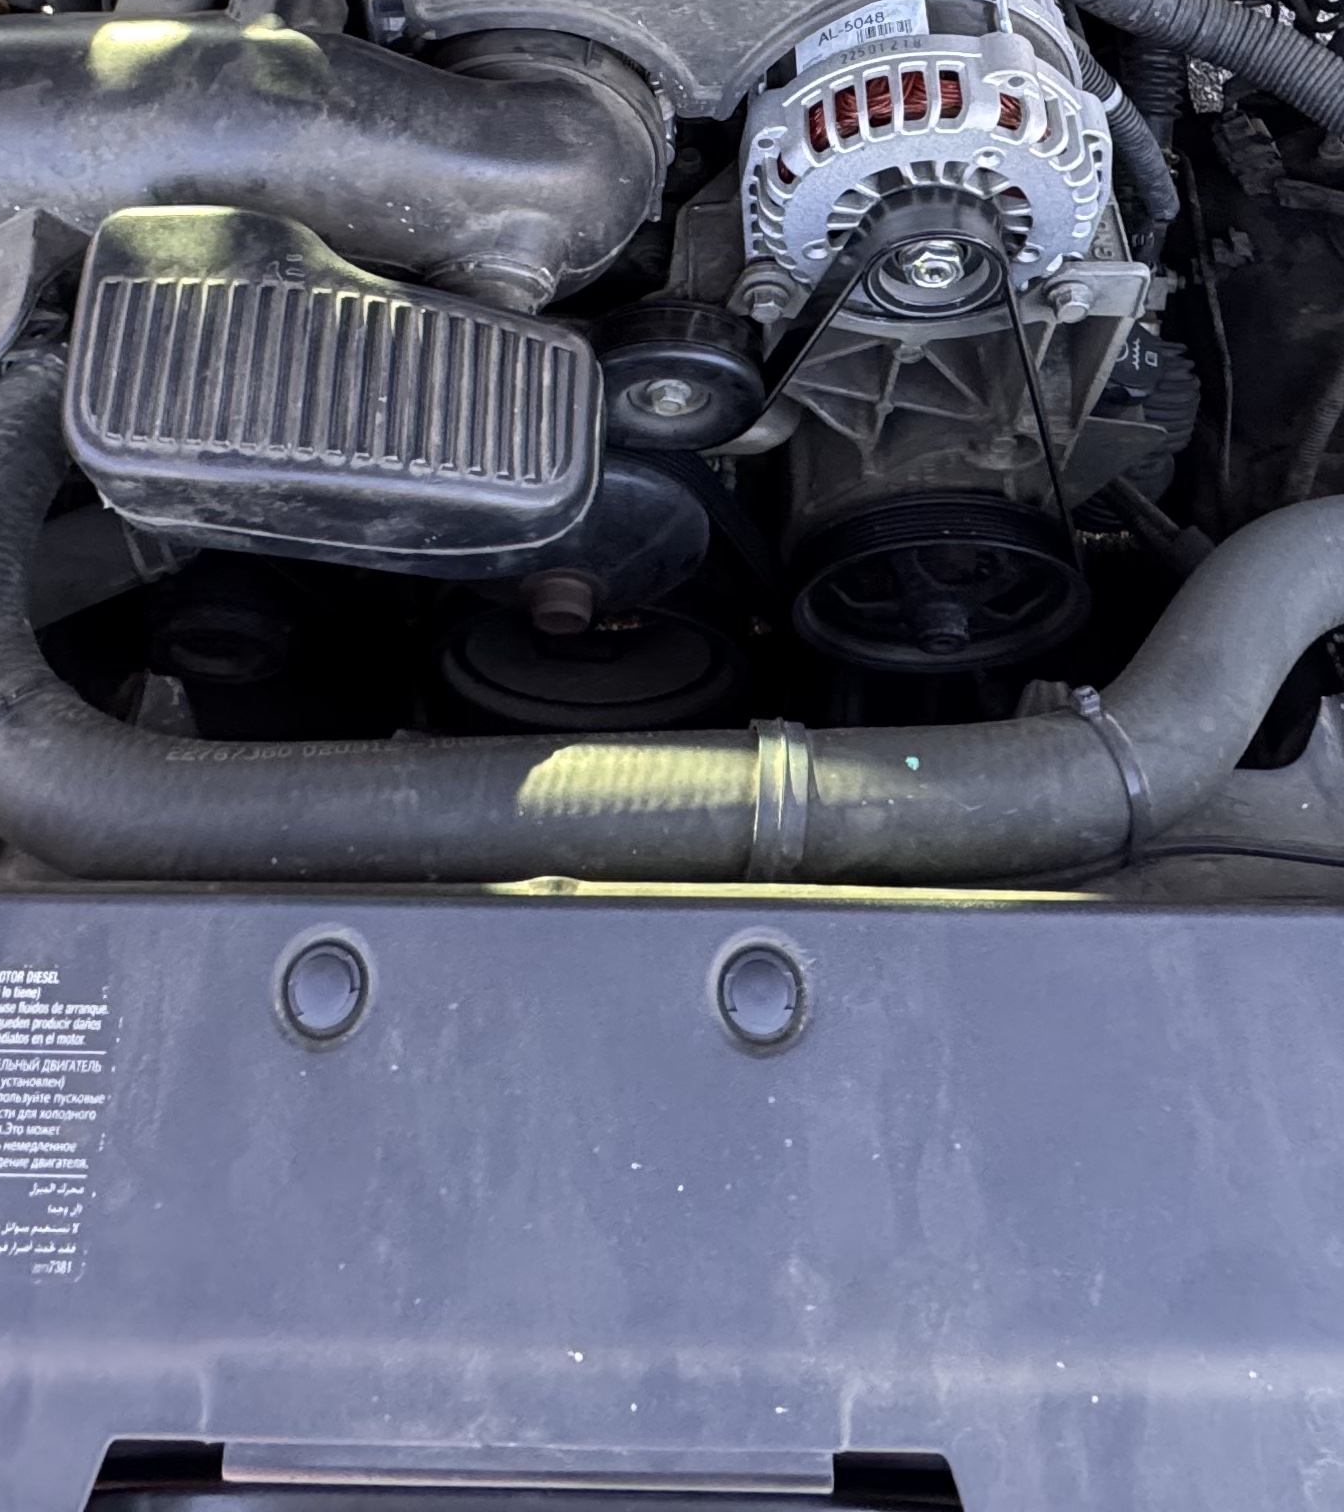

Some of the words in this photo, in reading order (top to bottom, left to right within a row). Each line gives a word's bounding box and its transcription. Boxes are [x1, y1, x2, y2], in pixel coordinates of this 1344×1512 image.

[818, 12, 884, 46] AL-5048
[26, 971, 59, 984] DIESEL
[14, 987, 41, 1000] tiene)
[0, 1004, 15, 1014] use
[51, 1003, 63, 1014] de
[41, 1059, 101, 1073] ДВИГАТЕЛЬ
